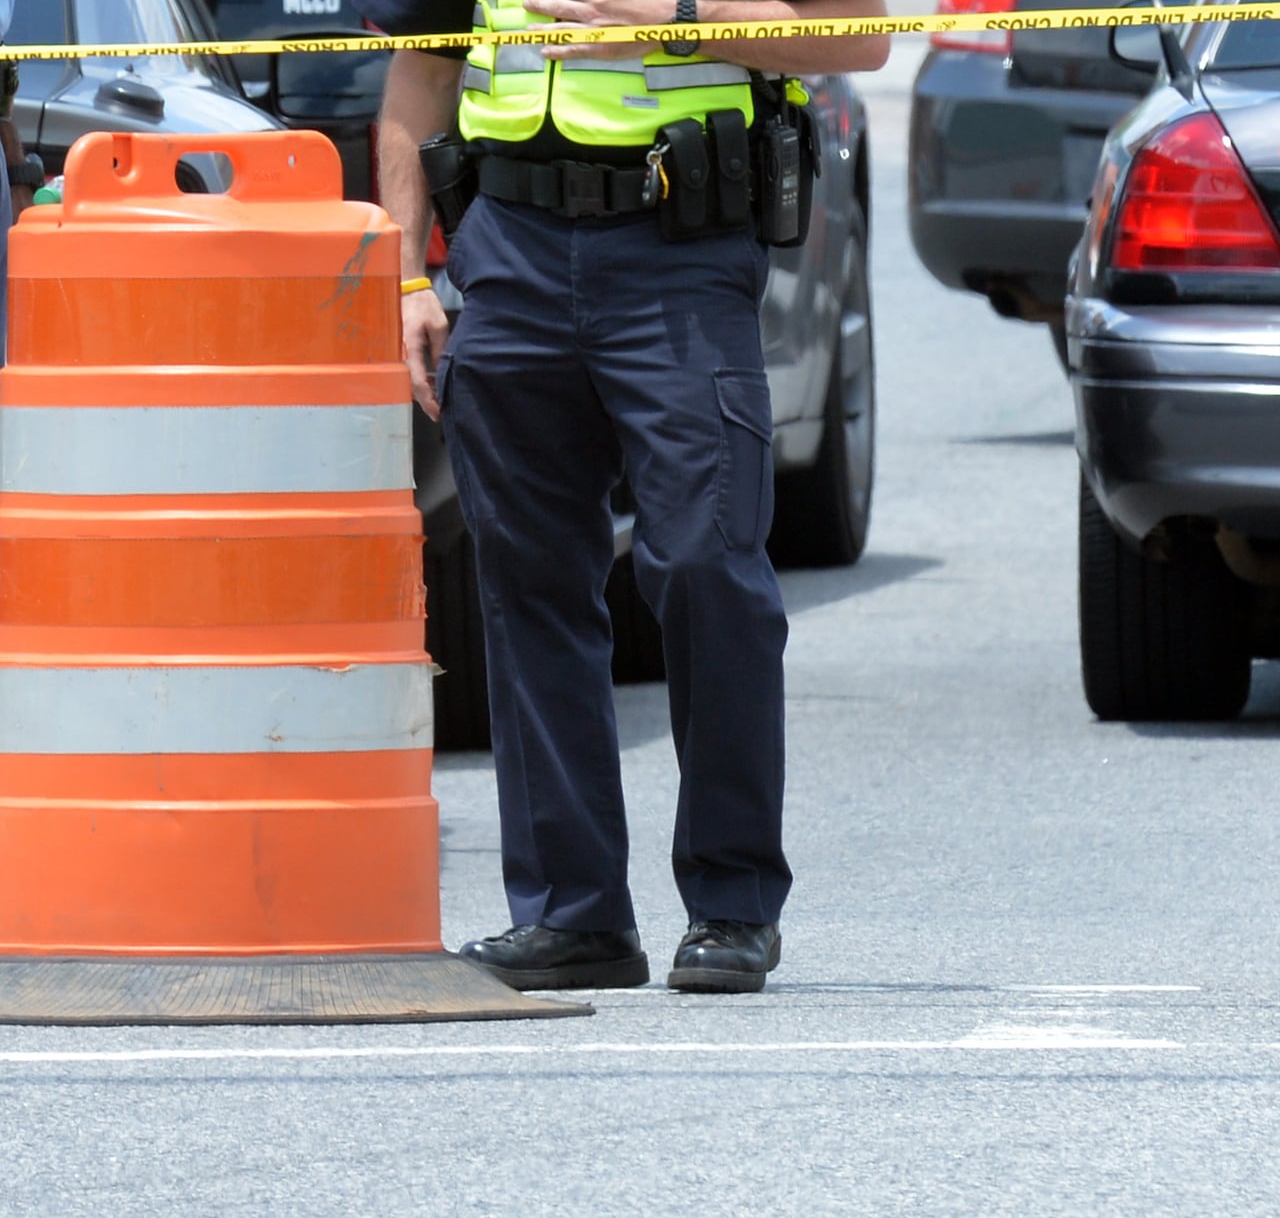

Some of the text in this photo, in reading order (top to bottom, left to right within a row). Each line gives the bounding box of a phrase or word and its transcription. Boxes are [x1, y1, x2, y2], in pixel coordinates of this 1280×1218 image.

[711, 28, 749, 41] NOT
[757, 26, 783, 39] DO
[791, 24, 835, 37] LINE
